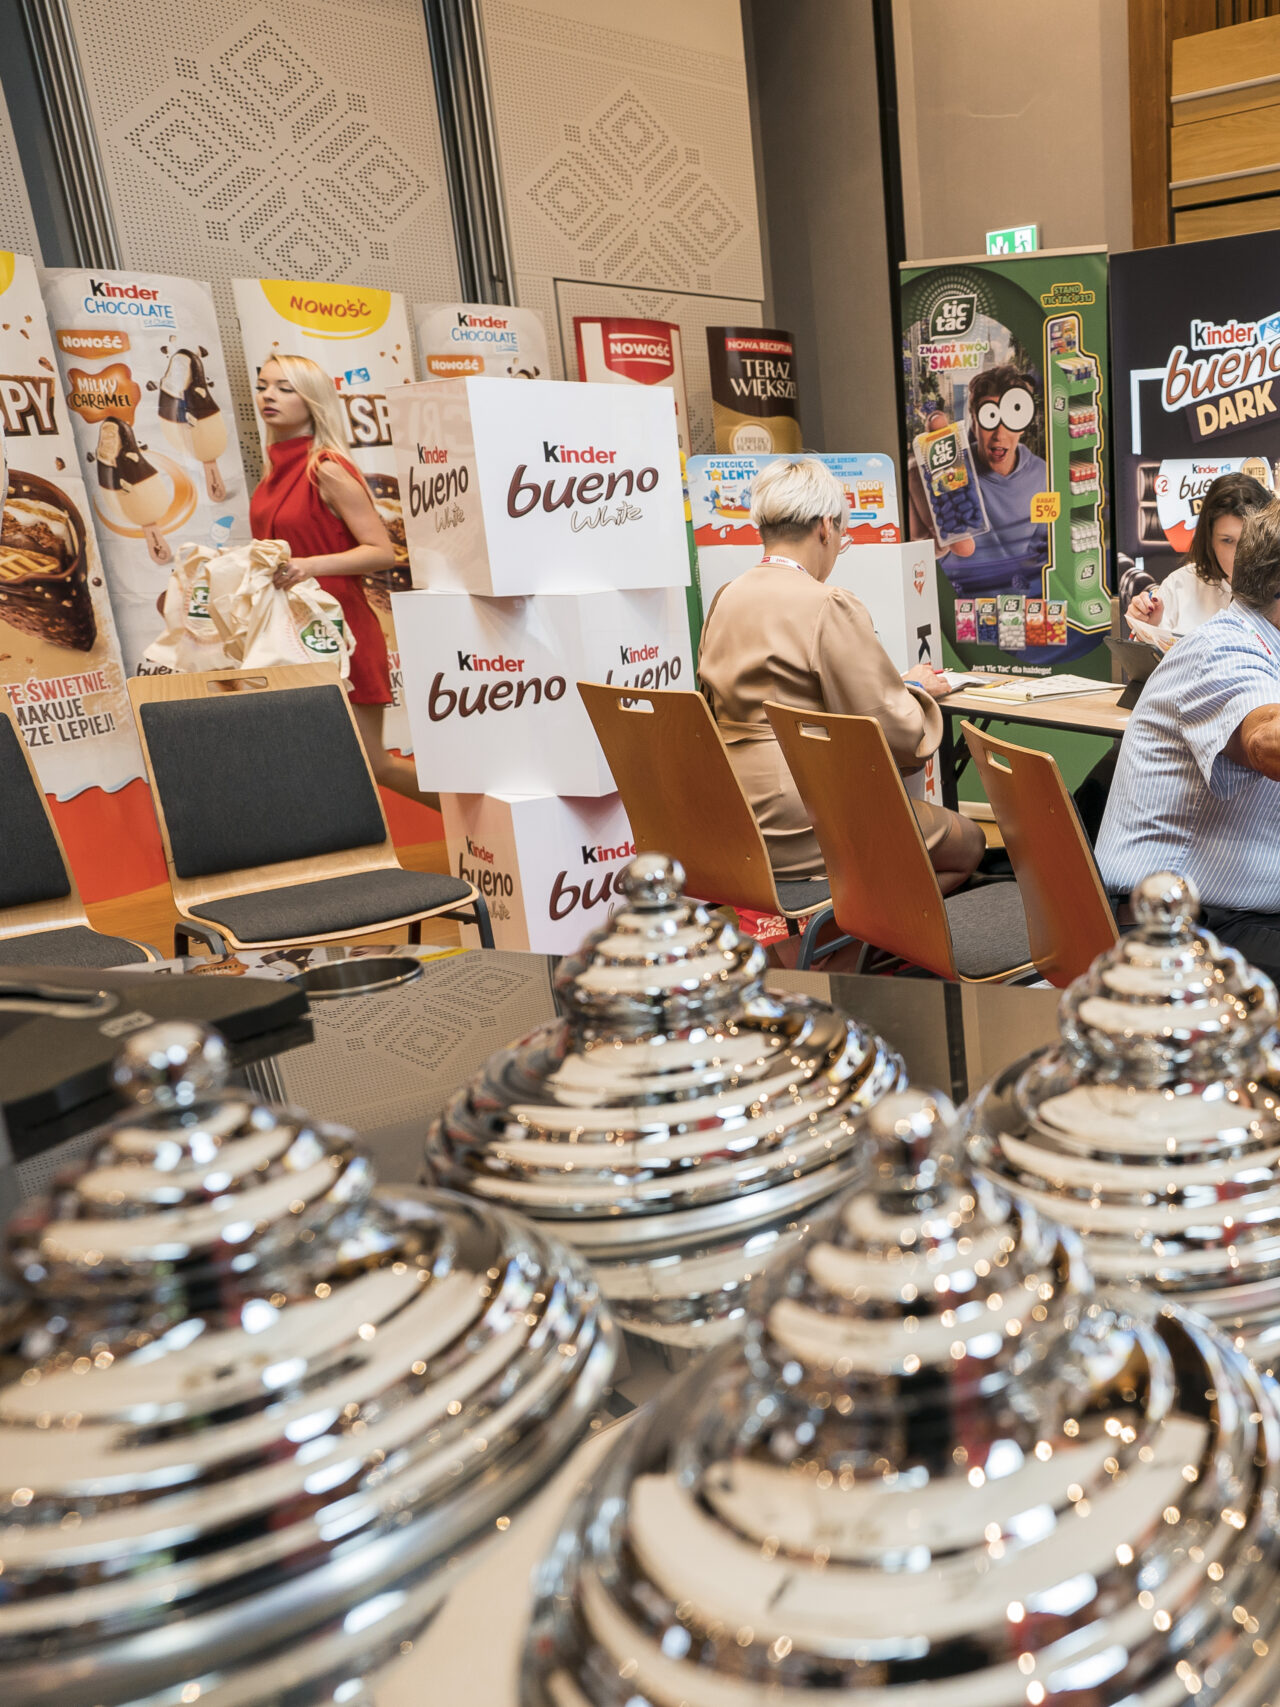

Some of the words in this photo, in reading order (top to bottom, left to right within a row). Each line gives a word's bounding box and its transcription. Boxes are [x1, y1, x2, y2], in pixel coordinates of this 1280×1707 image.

[89, 279, 159, 301] Kinder
[84, 297, 174, 319] CHOCOLATE
[289, 294, 373, 319] NOWOŚĆ
[942, 300, 970, 317] tic
[457, 312, 509, 331] Kinder
[936, 316, 968, 332] tac
[451, 326, 518, 346] CHOCOLATE
[727, 340, 758, 351] NOWA
[1195, 323, 1254, 346] Kinder
[610, 340, 671, 359] NOWOŚĆ
[960, 340, 988, 352] SWÓJ
[741, 359, 790, 380] TERAZ
[930, 354, 977, 369] SMAK!
[72, 394, 132, 411] CARAMEL
[1196, 380, 1277, 436] DARK
[417, 442, 448, 464] Kinder
[543, 440, 617, 464] Kinder
[932, 450, 954, 466] tac
[934, 440, 954, 455] tic
[1192, 463, 1218, 474] Kinder
[409, 465, 468, 518] bueno
[506, 464, 659, 518] bueno
[1179, 475, 1212, 500] bue
[570, 501, 643, 533] White
[1035, 505, 1057, 518] 5%
[457, 650, 525, 672] Kinder
[620, 644, 660, 666] Kinder
[26, 671, 112, 703] ŚWIETNIE,
[428, 672, 566, 722] bueno
[57, 712, 116, 742] LEPIEJ!
[466, 835, 494, 865] Kinder
[581, 841, 637, 865] Kinde
[549, 870, 626, 921] bue
